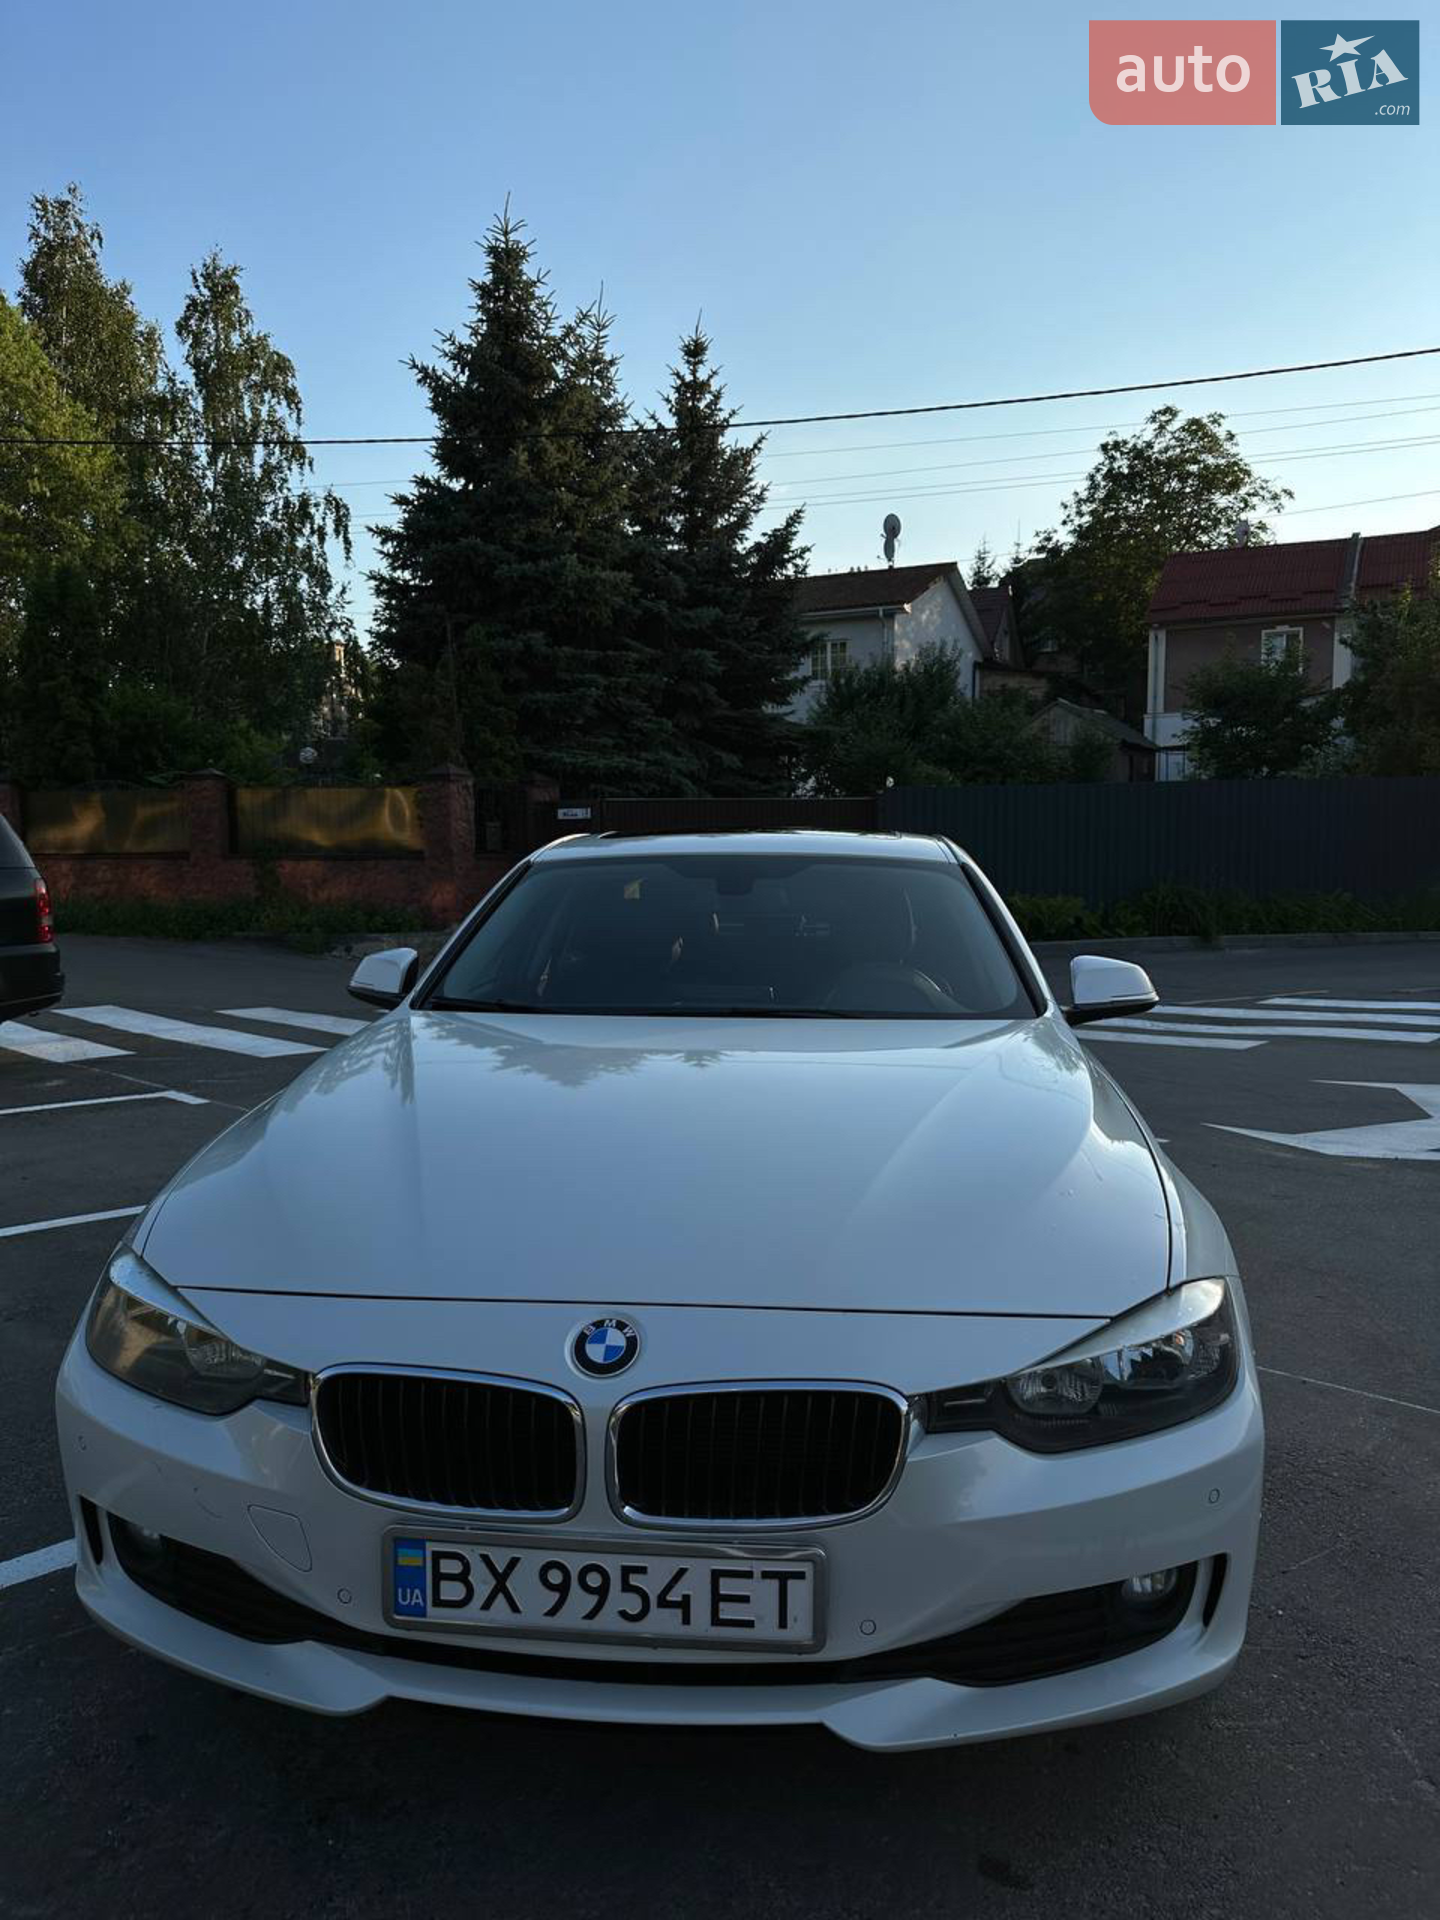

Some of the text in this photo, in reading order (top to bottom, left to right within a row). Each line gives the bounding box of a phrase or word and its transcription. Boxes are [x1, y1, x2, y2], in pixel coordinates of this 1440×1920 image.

[583, 1319, 636, 1337] BMW
[398, 1588, 424, 1607] UA
[431, 1550, 806, 1630] BX 9954 ET
